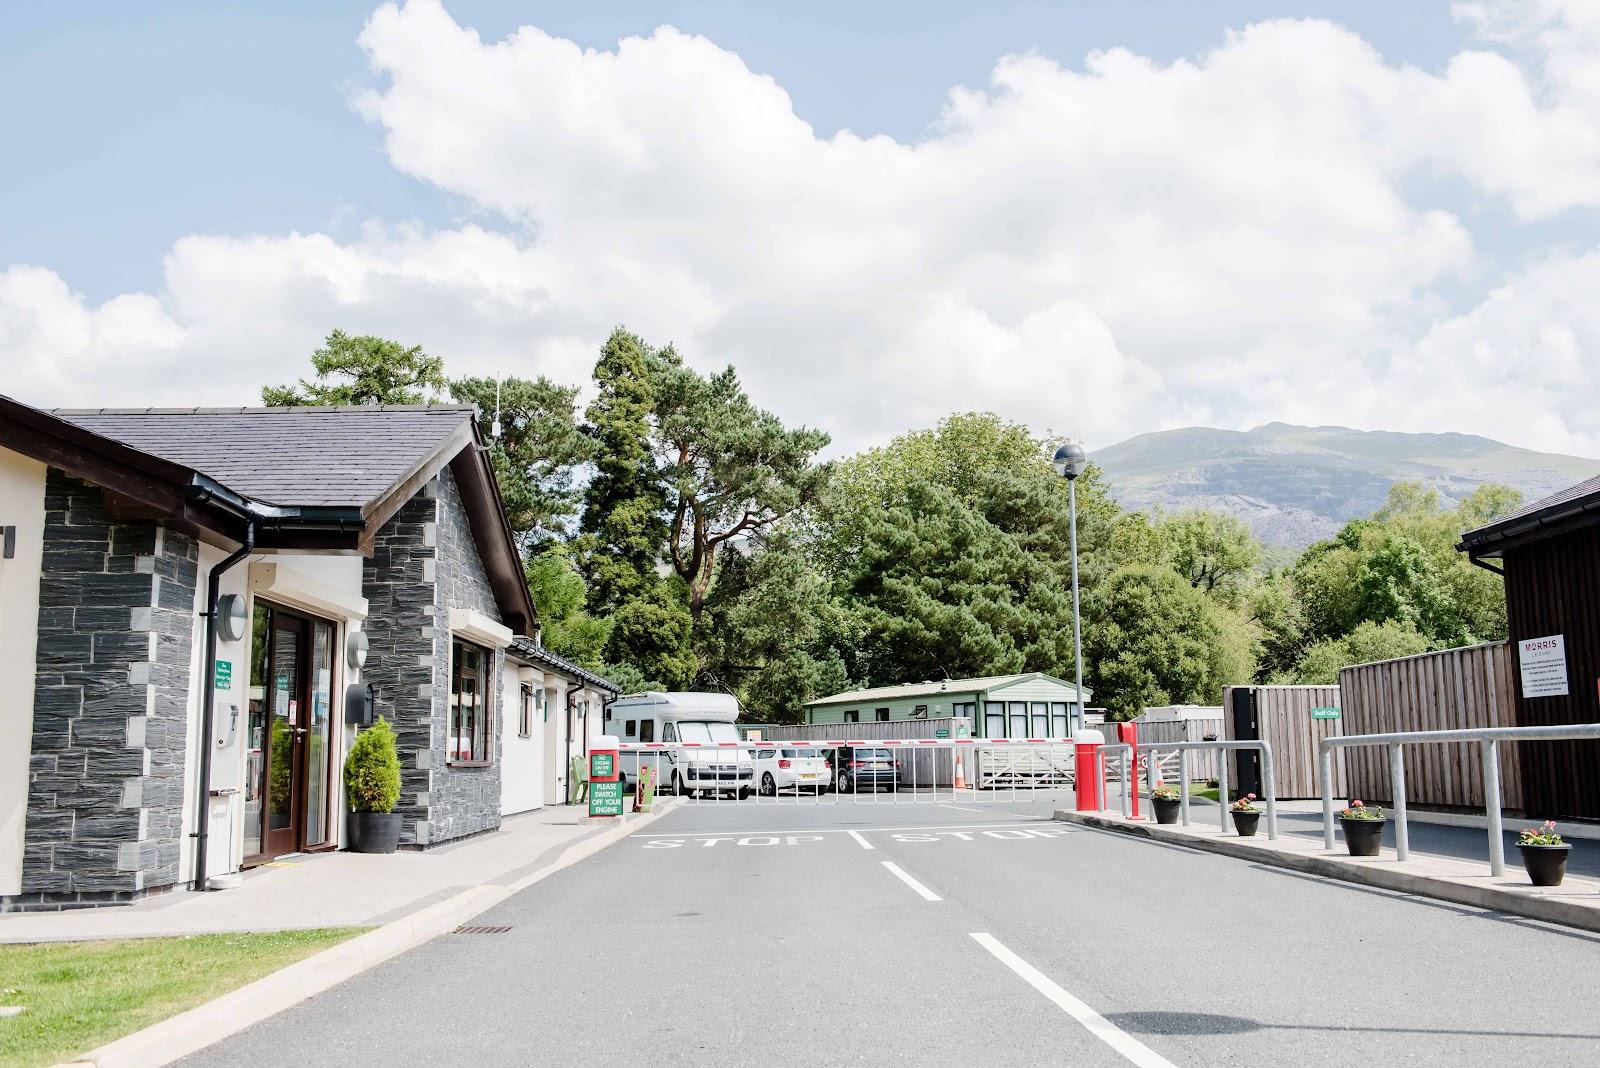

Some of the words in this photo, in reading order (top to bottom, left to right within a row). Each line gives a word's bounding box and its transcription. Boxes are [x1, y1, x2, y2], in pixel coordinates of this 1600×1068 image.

[1525, 640, 1557, 652] MORRIS
[595, 806, 618, 814] ENGINE
[641, 835, 825, 849] STOP
[890, 829, 1070, 843] STOP
